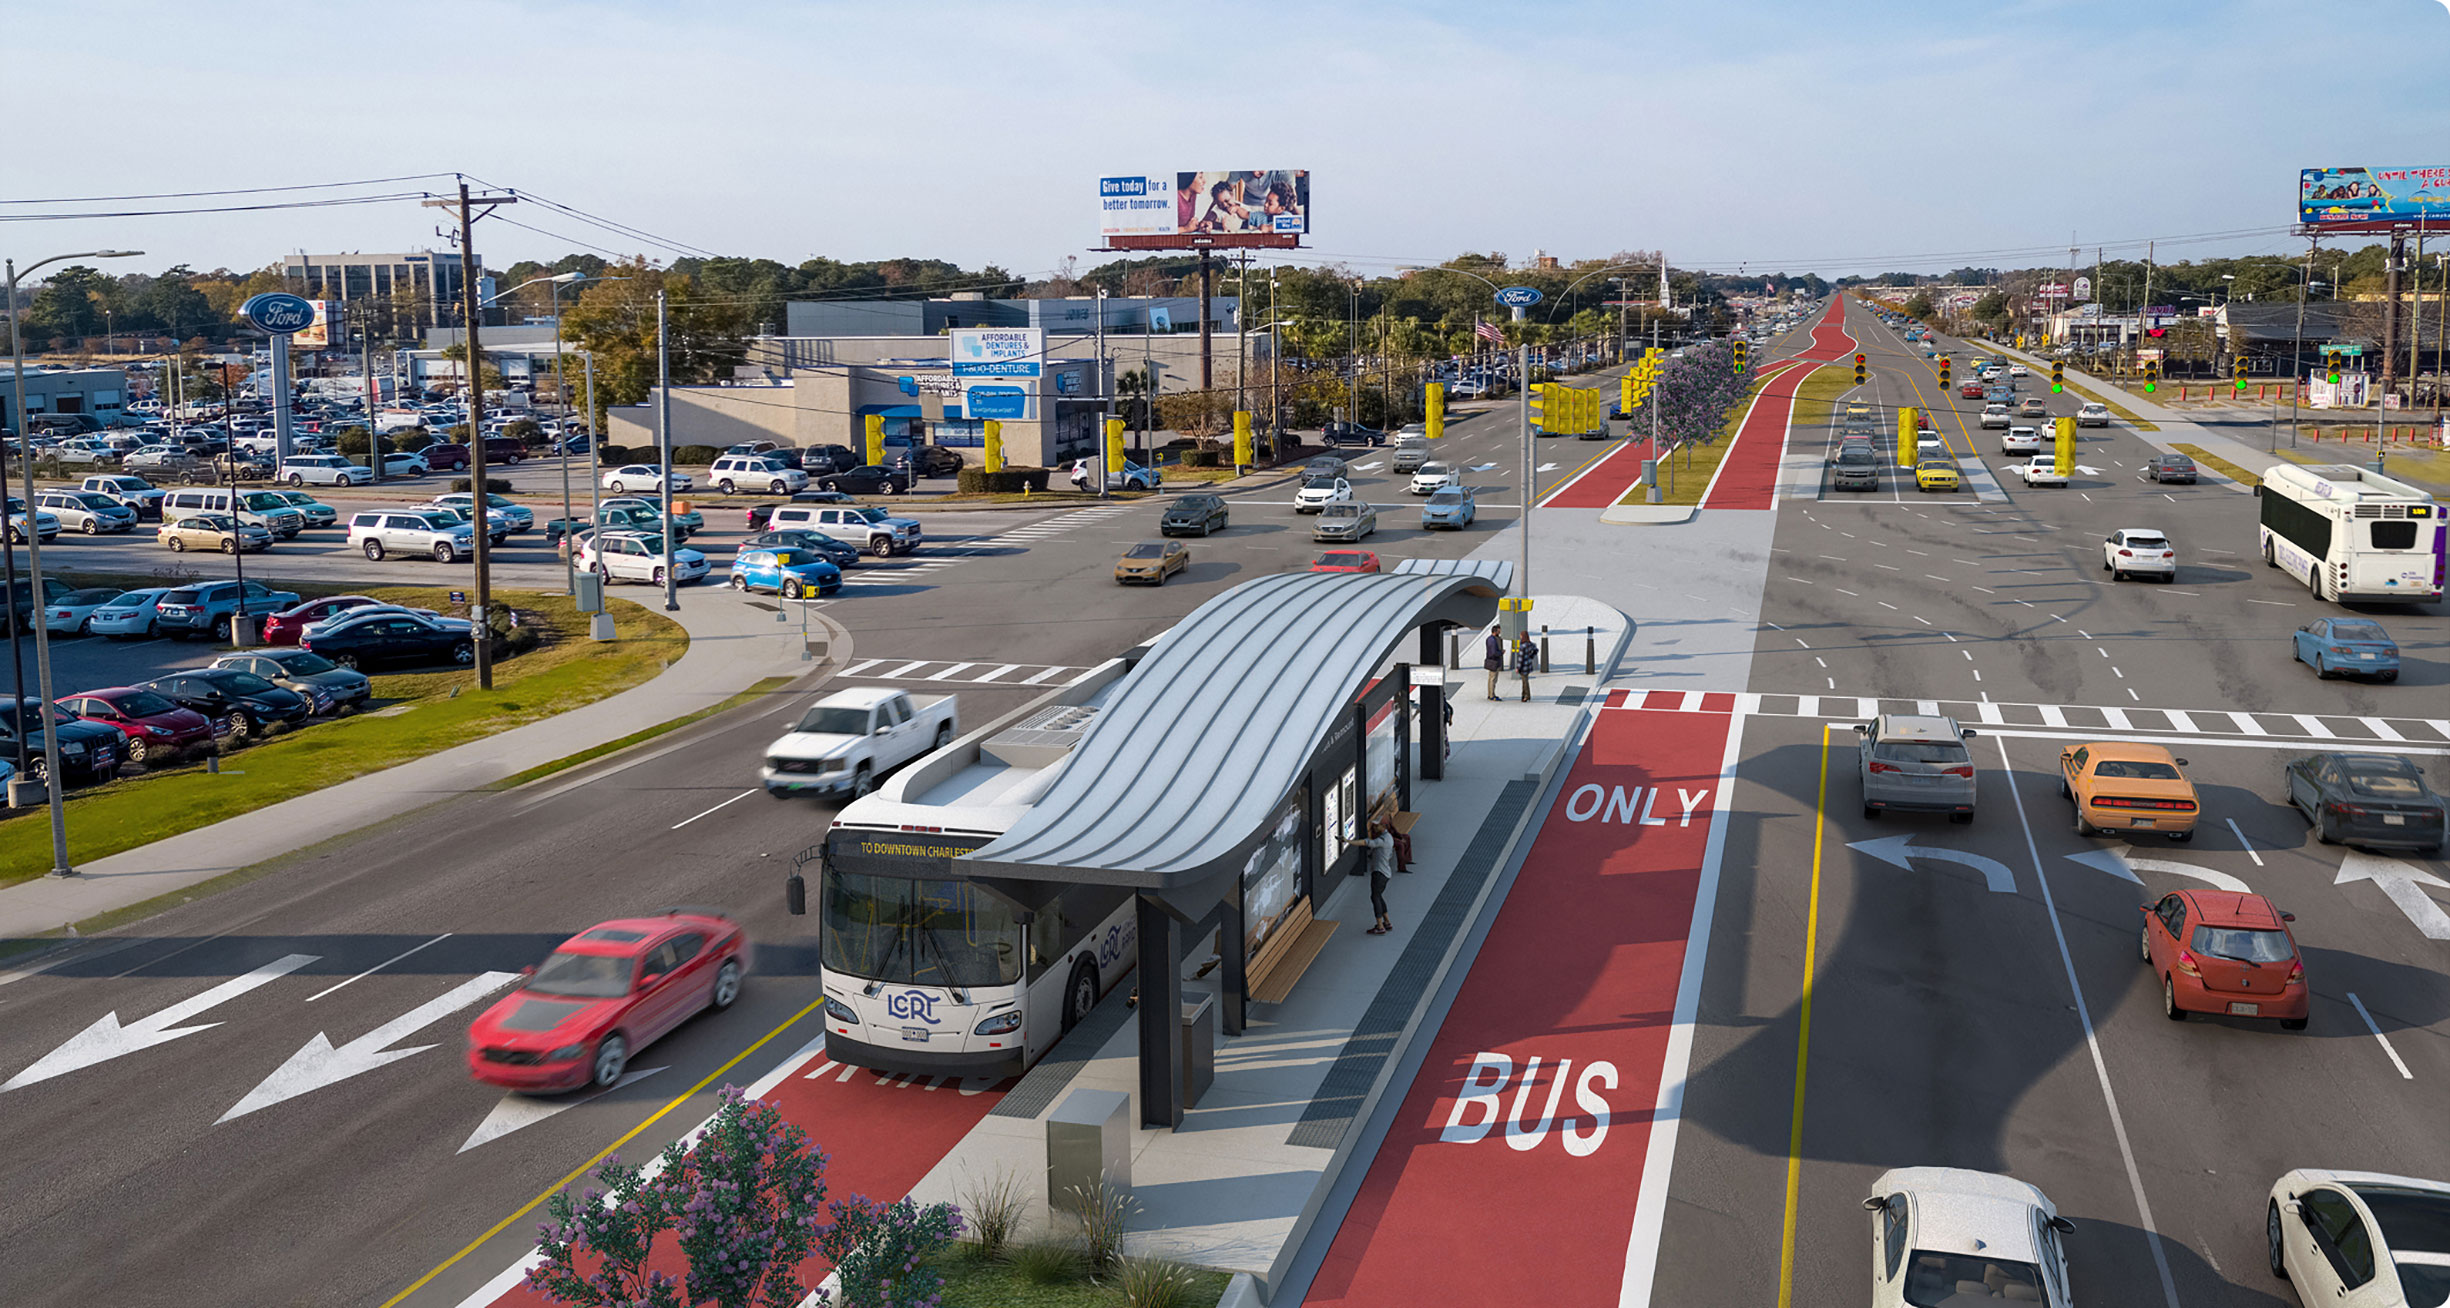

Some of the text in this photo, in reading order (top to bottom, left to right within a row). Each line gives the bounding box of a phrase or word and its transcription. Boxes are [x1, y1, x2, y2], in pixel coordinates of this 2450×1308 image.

[2378, 171, 2407, 180] UNTIL
[1102, 180, 1167, 194] Give today for a
[1103, 199, 1170, 210] better tomorrow.
[1504, 290, 1533, 303] Ford
[264, 301, 304, 326] Ford
[981, 333, 1027, 341] AFFORDABLE
[986, 341, 1023, 350] DENTURES
[990, 350, 1026, 358] IMPLANTS
[1565, 783, 1709, 827] ONLY
[861, 842, 873, 854] TO
[874, 843, 926, 857] DOWNTOWN
[888, 989, 941, 1025] LCRT
[1439, 1051, 1619, 1157] BUS
